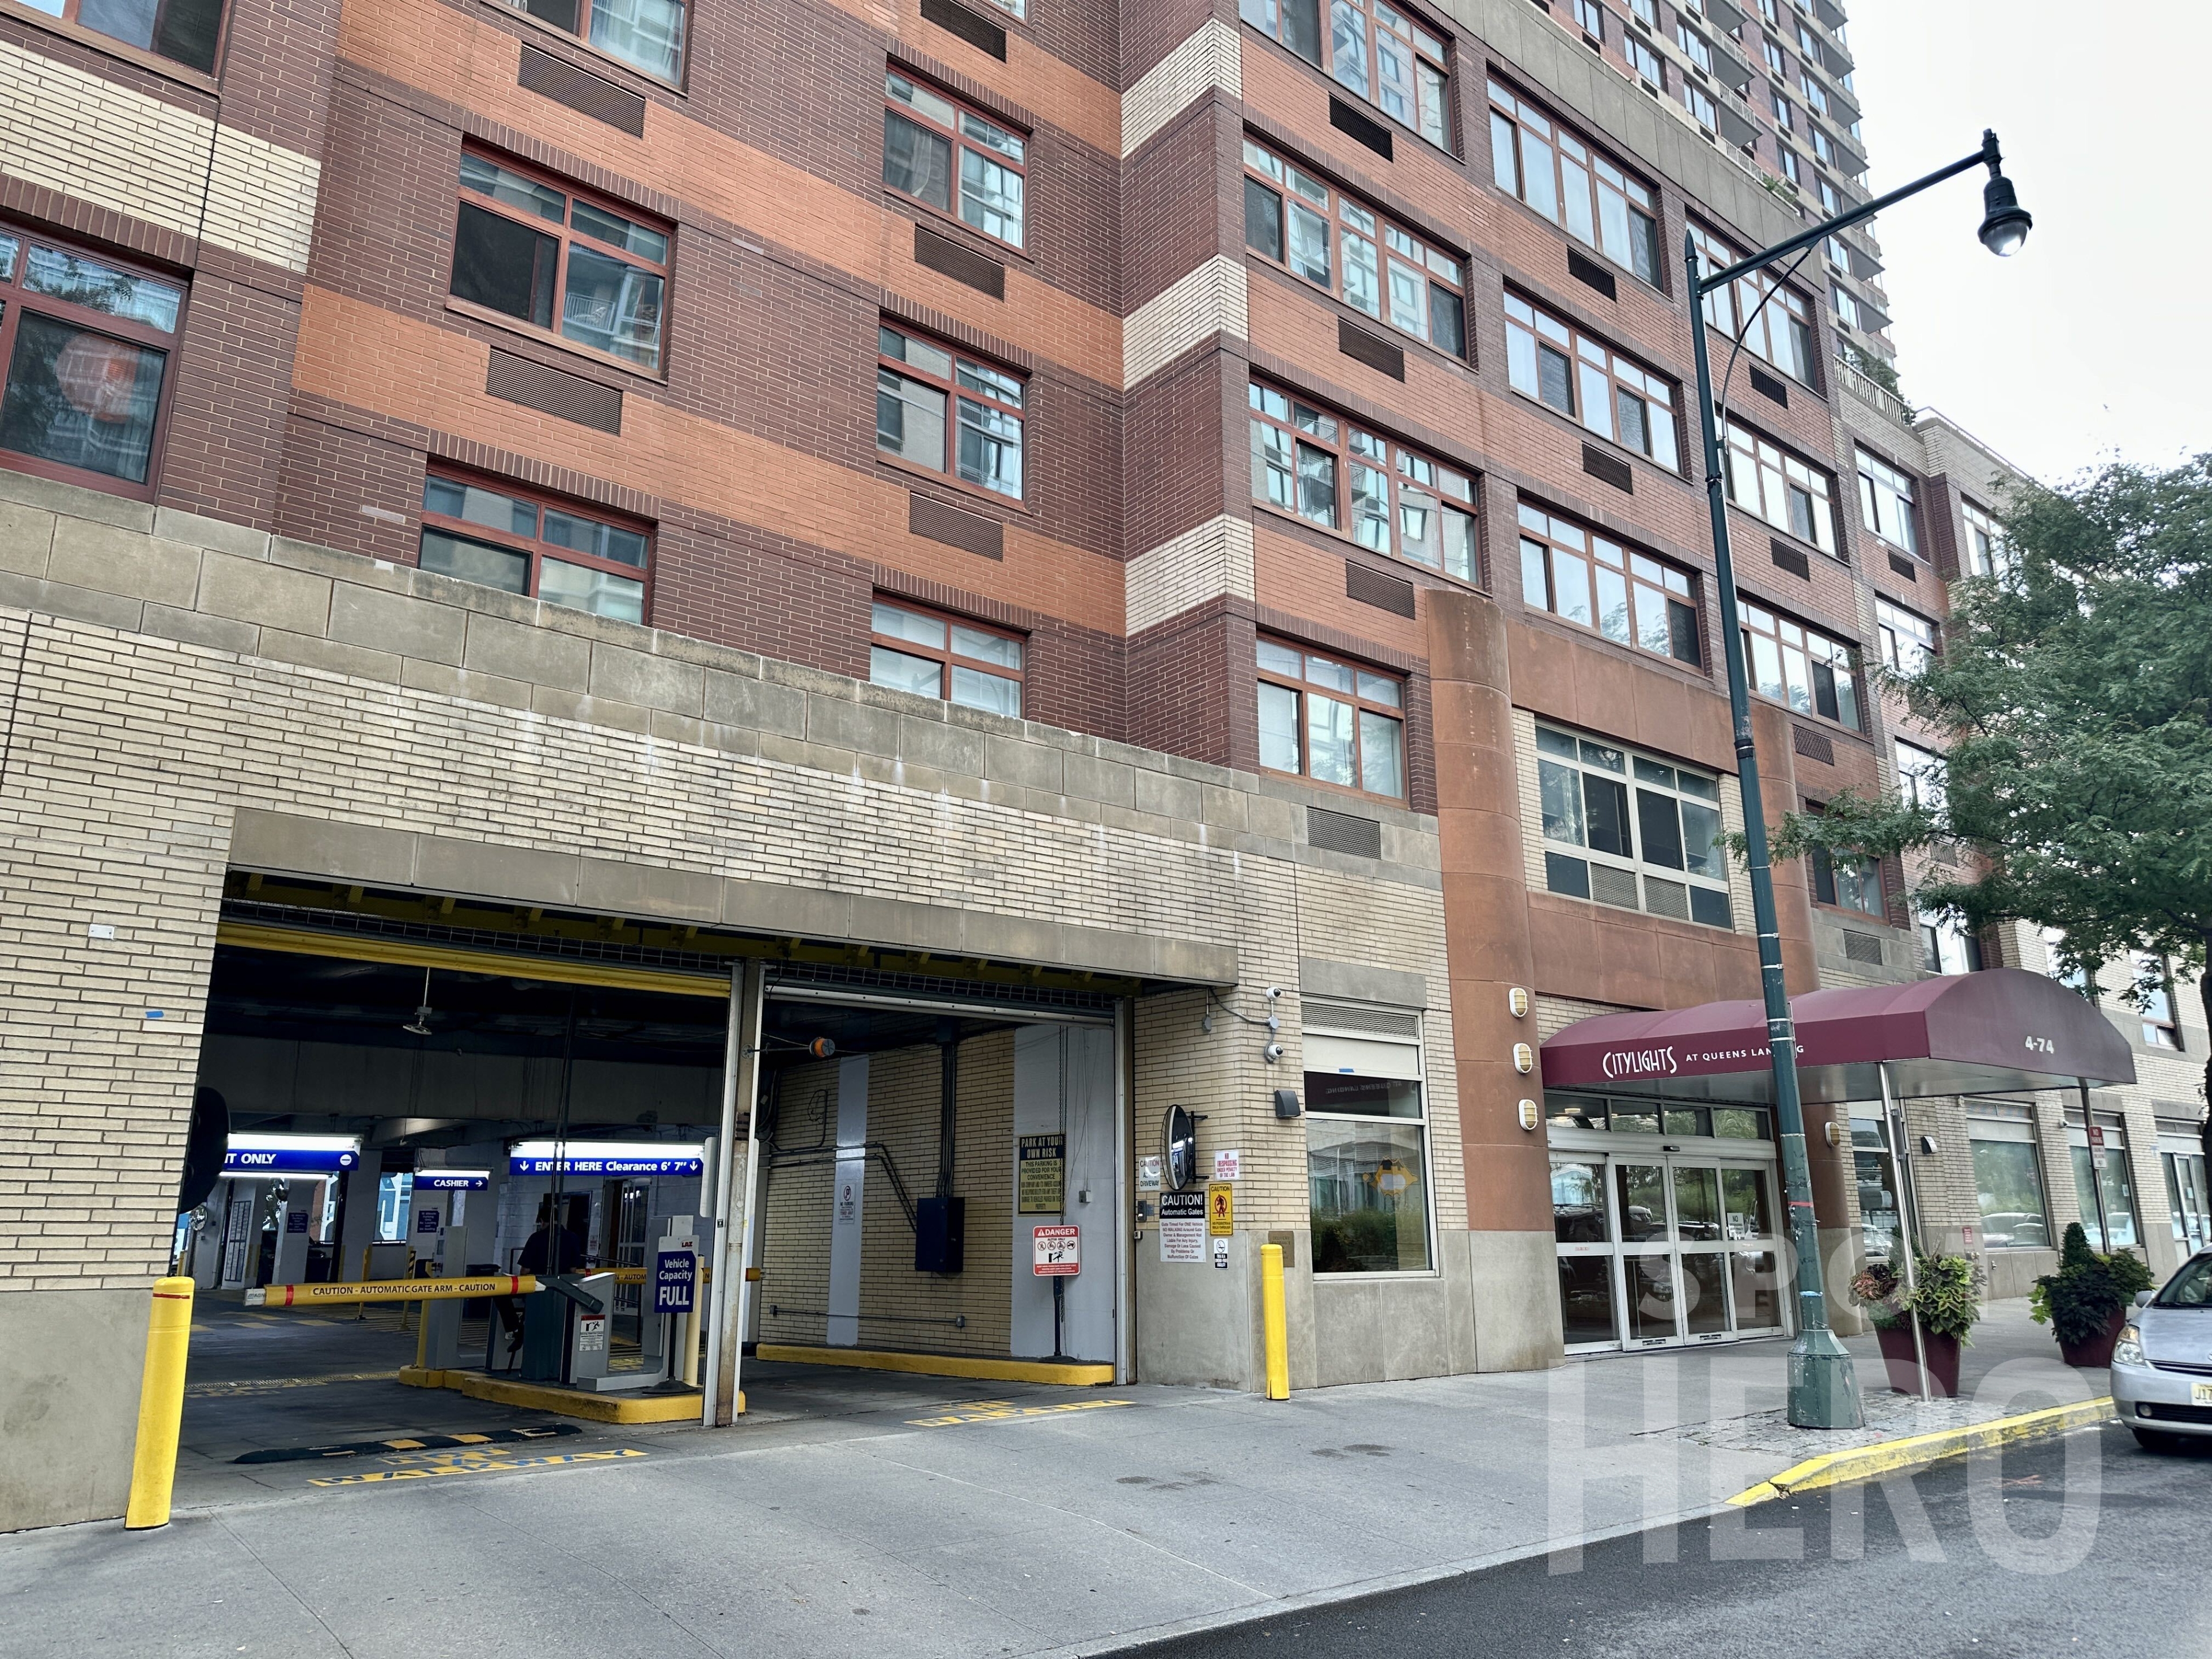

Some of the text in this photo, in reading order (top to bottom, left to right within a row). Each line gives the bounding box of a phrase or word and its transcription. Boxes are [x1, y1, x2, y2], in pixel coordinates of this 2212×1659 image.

[2025, 1036, 2054, 1054] 4-74
[1602, 1045, 1804, 1079] CITYLIGHTS AT QUEENS LANG
[1021, 1136, 1063, 1148] PARK AT YOUR
[224, 1153, 276, 1164] IT ONLY
[1027, 1147, 1056, 1159] OWN RISK
[574, 1161, 602, 1171] HERE
[606, 1161, 657, 1171] Clearance
[1161, 1194, 1203, 1206] CAUTION!
[664, 1258, 690, 1268] Vehicle
[659, 1270, 692, 1282] Capacity
[313, 1287, 353, 1295] CAUTION
[360, 1285, 410, 1294] AUTOMATIC
[459, 1283, 495, 1291] CAUTION
[659, 1286, 690, 1306] FULL
[316, 1449, 627, 1484] WALKWAY
